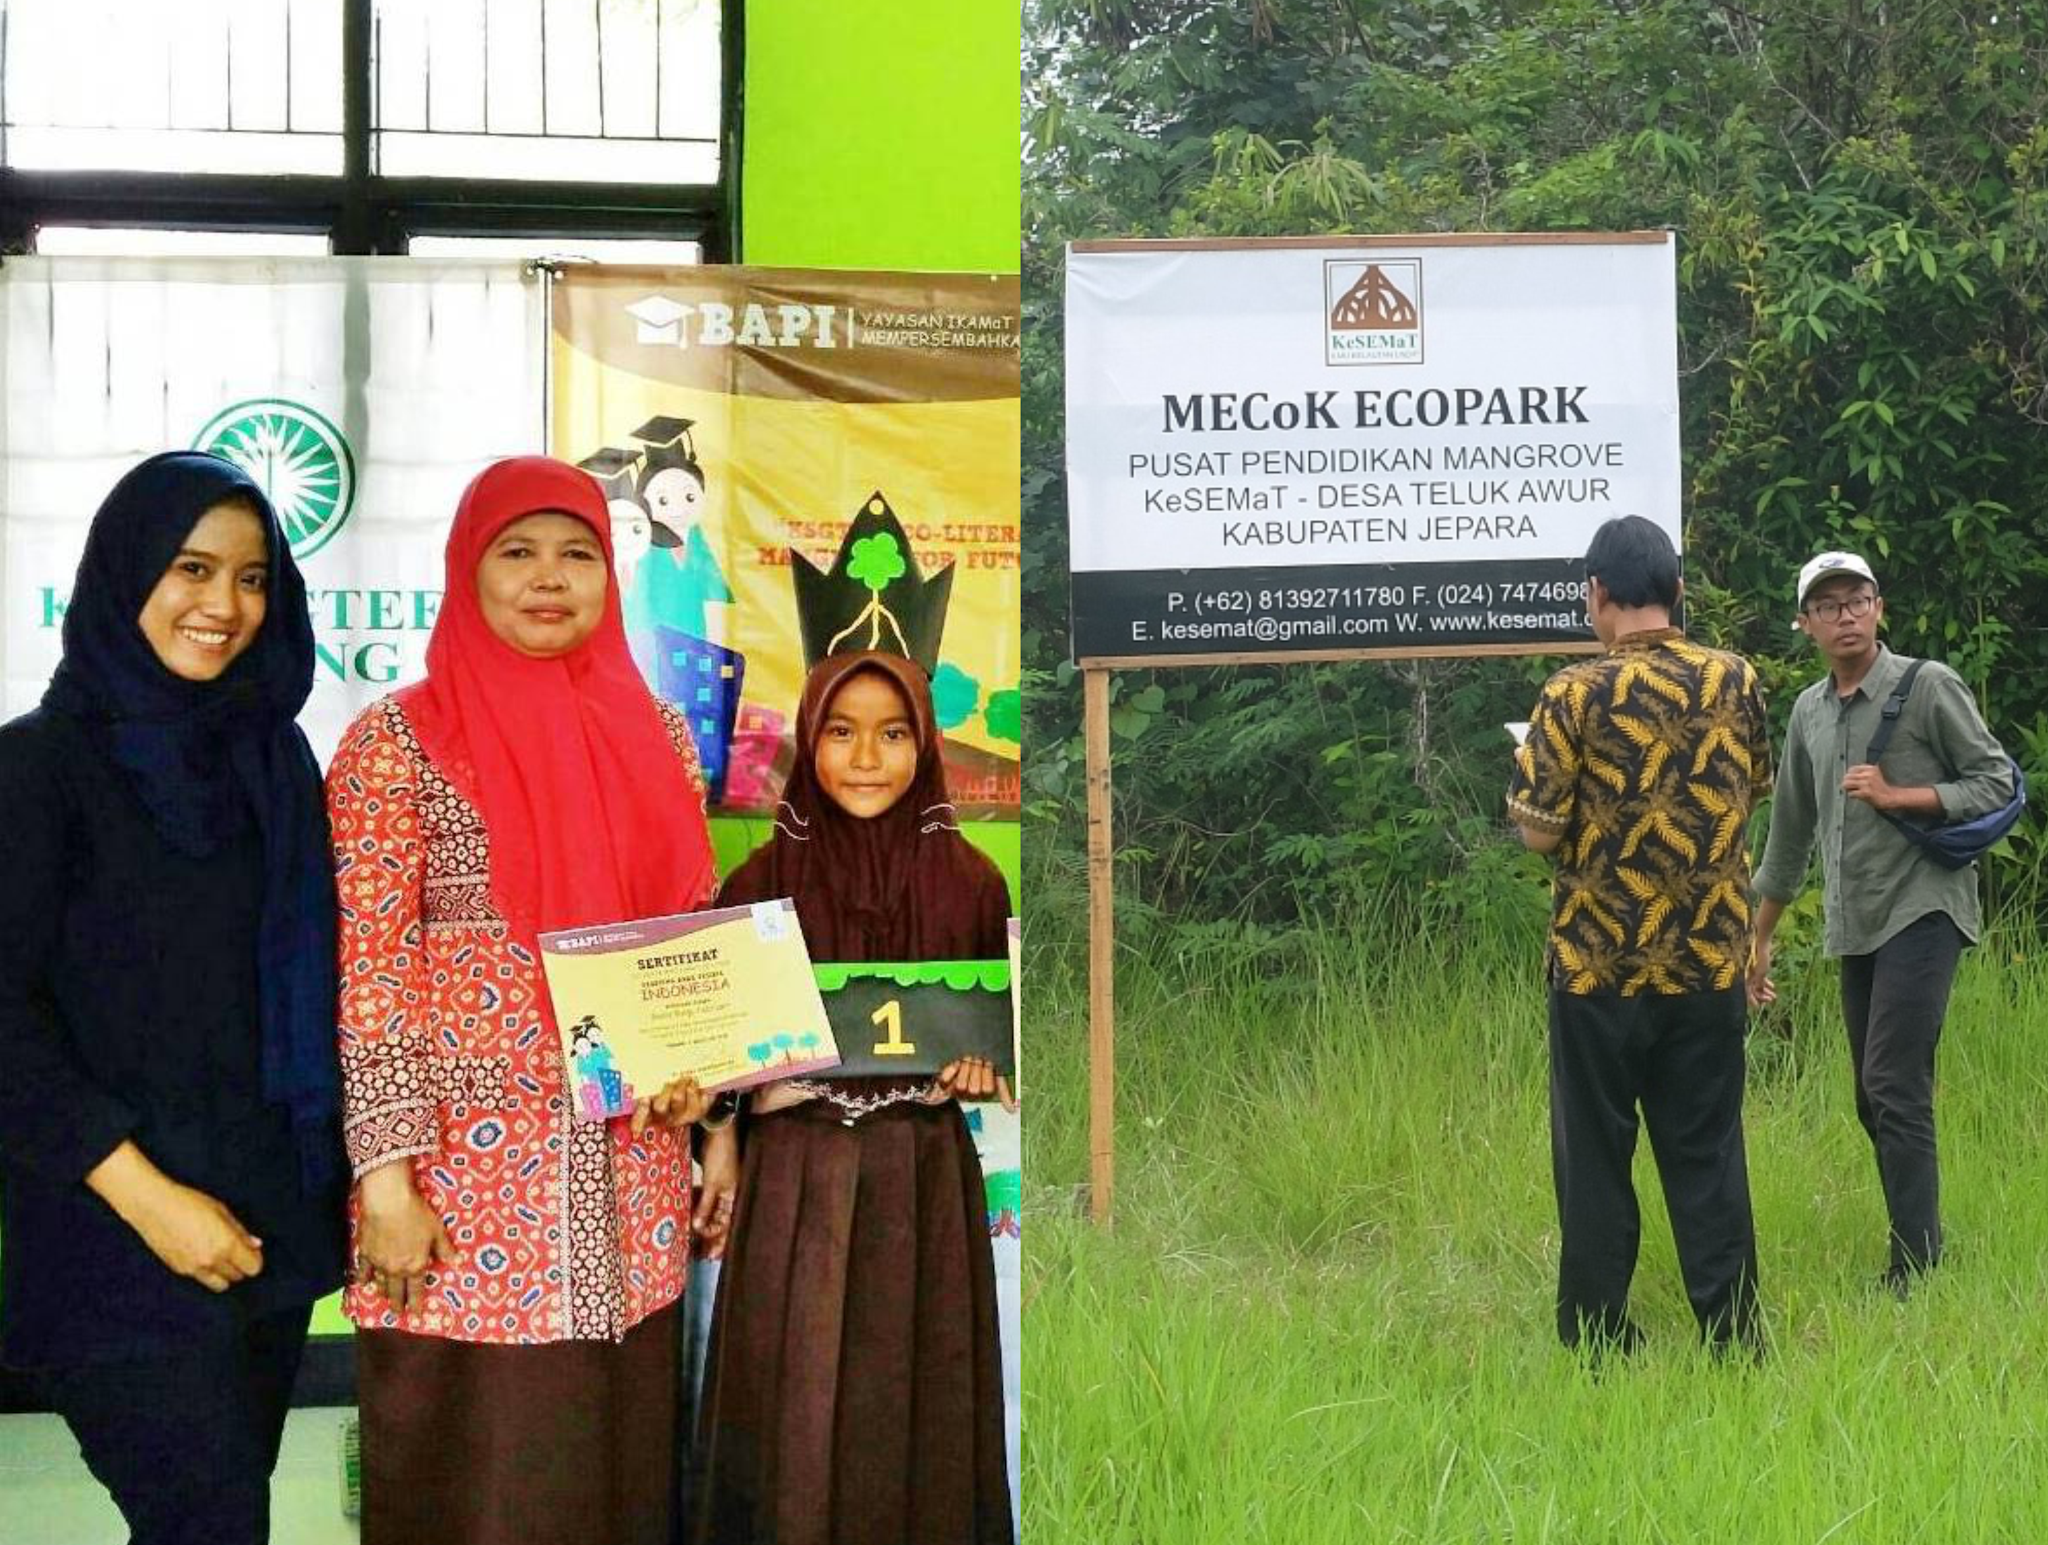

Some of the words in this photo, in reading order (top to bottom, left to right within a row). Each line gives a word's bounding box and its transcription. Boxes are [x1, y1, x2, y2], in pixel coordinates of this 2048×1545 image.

[699, 303, 836, 348] BAPI
[861, 312, 943, 329] YAYASAN
[1332, 334, 1418, 349] KeSEMaT
[1162, 391, 1340, 433] MECoK
[1354, 386, 1590, 428] ECOPARK
[1129, 452, 1232, 478] PUSAT
[1242, 448, 1432, 475] PENDIDIKAN
[1444, 442, 1623, 470] MANGROVE
[1145, 485, 1288, 513] KeSEMaT
[1318, 483, 1402, 509] DESA
[1410, 480, 1509, 506] TELUK
[1518, 478, 1610, 503] AWUR
[1223, 518, 1406, 546] KABUPATEN
[1418, 514, 1538, 541] JEPARA
[1167, 591, 1187, 612] P.
[1195, 590, 1251, 616] (+62)
[1258, 586, 1404, 610] 81392711780
[1413, 585, 1430, 605] F.
[1437, 583, 1493, 609] (024)
[1131, 620, 1153, 641] E.
[1162, 615, 1388, 641] kesemat@gmail.com
[1395, 613, 1422, 631] W.
[637, 948, 718, 970] SERTIFIKAT
[642, 977, 731, 1001] INDONESIA
[871, 1000, 915, 1054] 1
